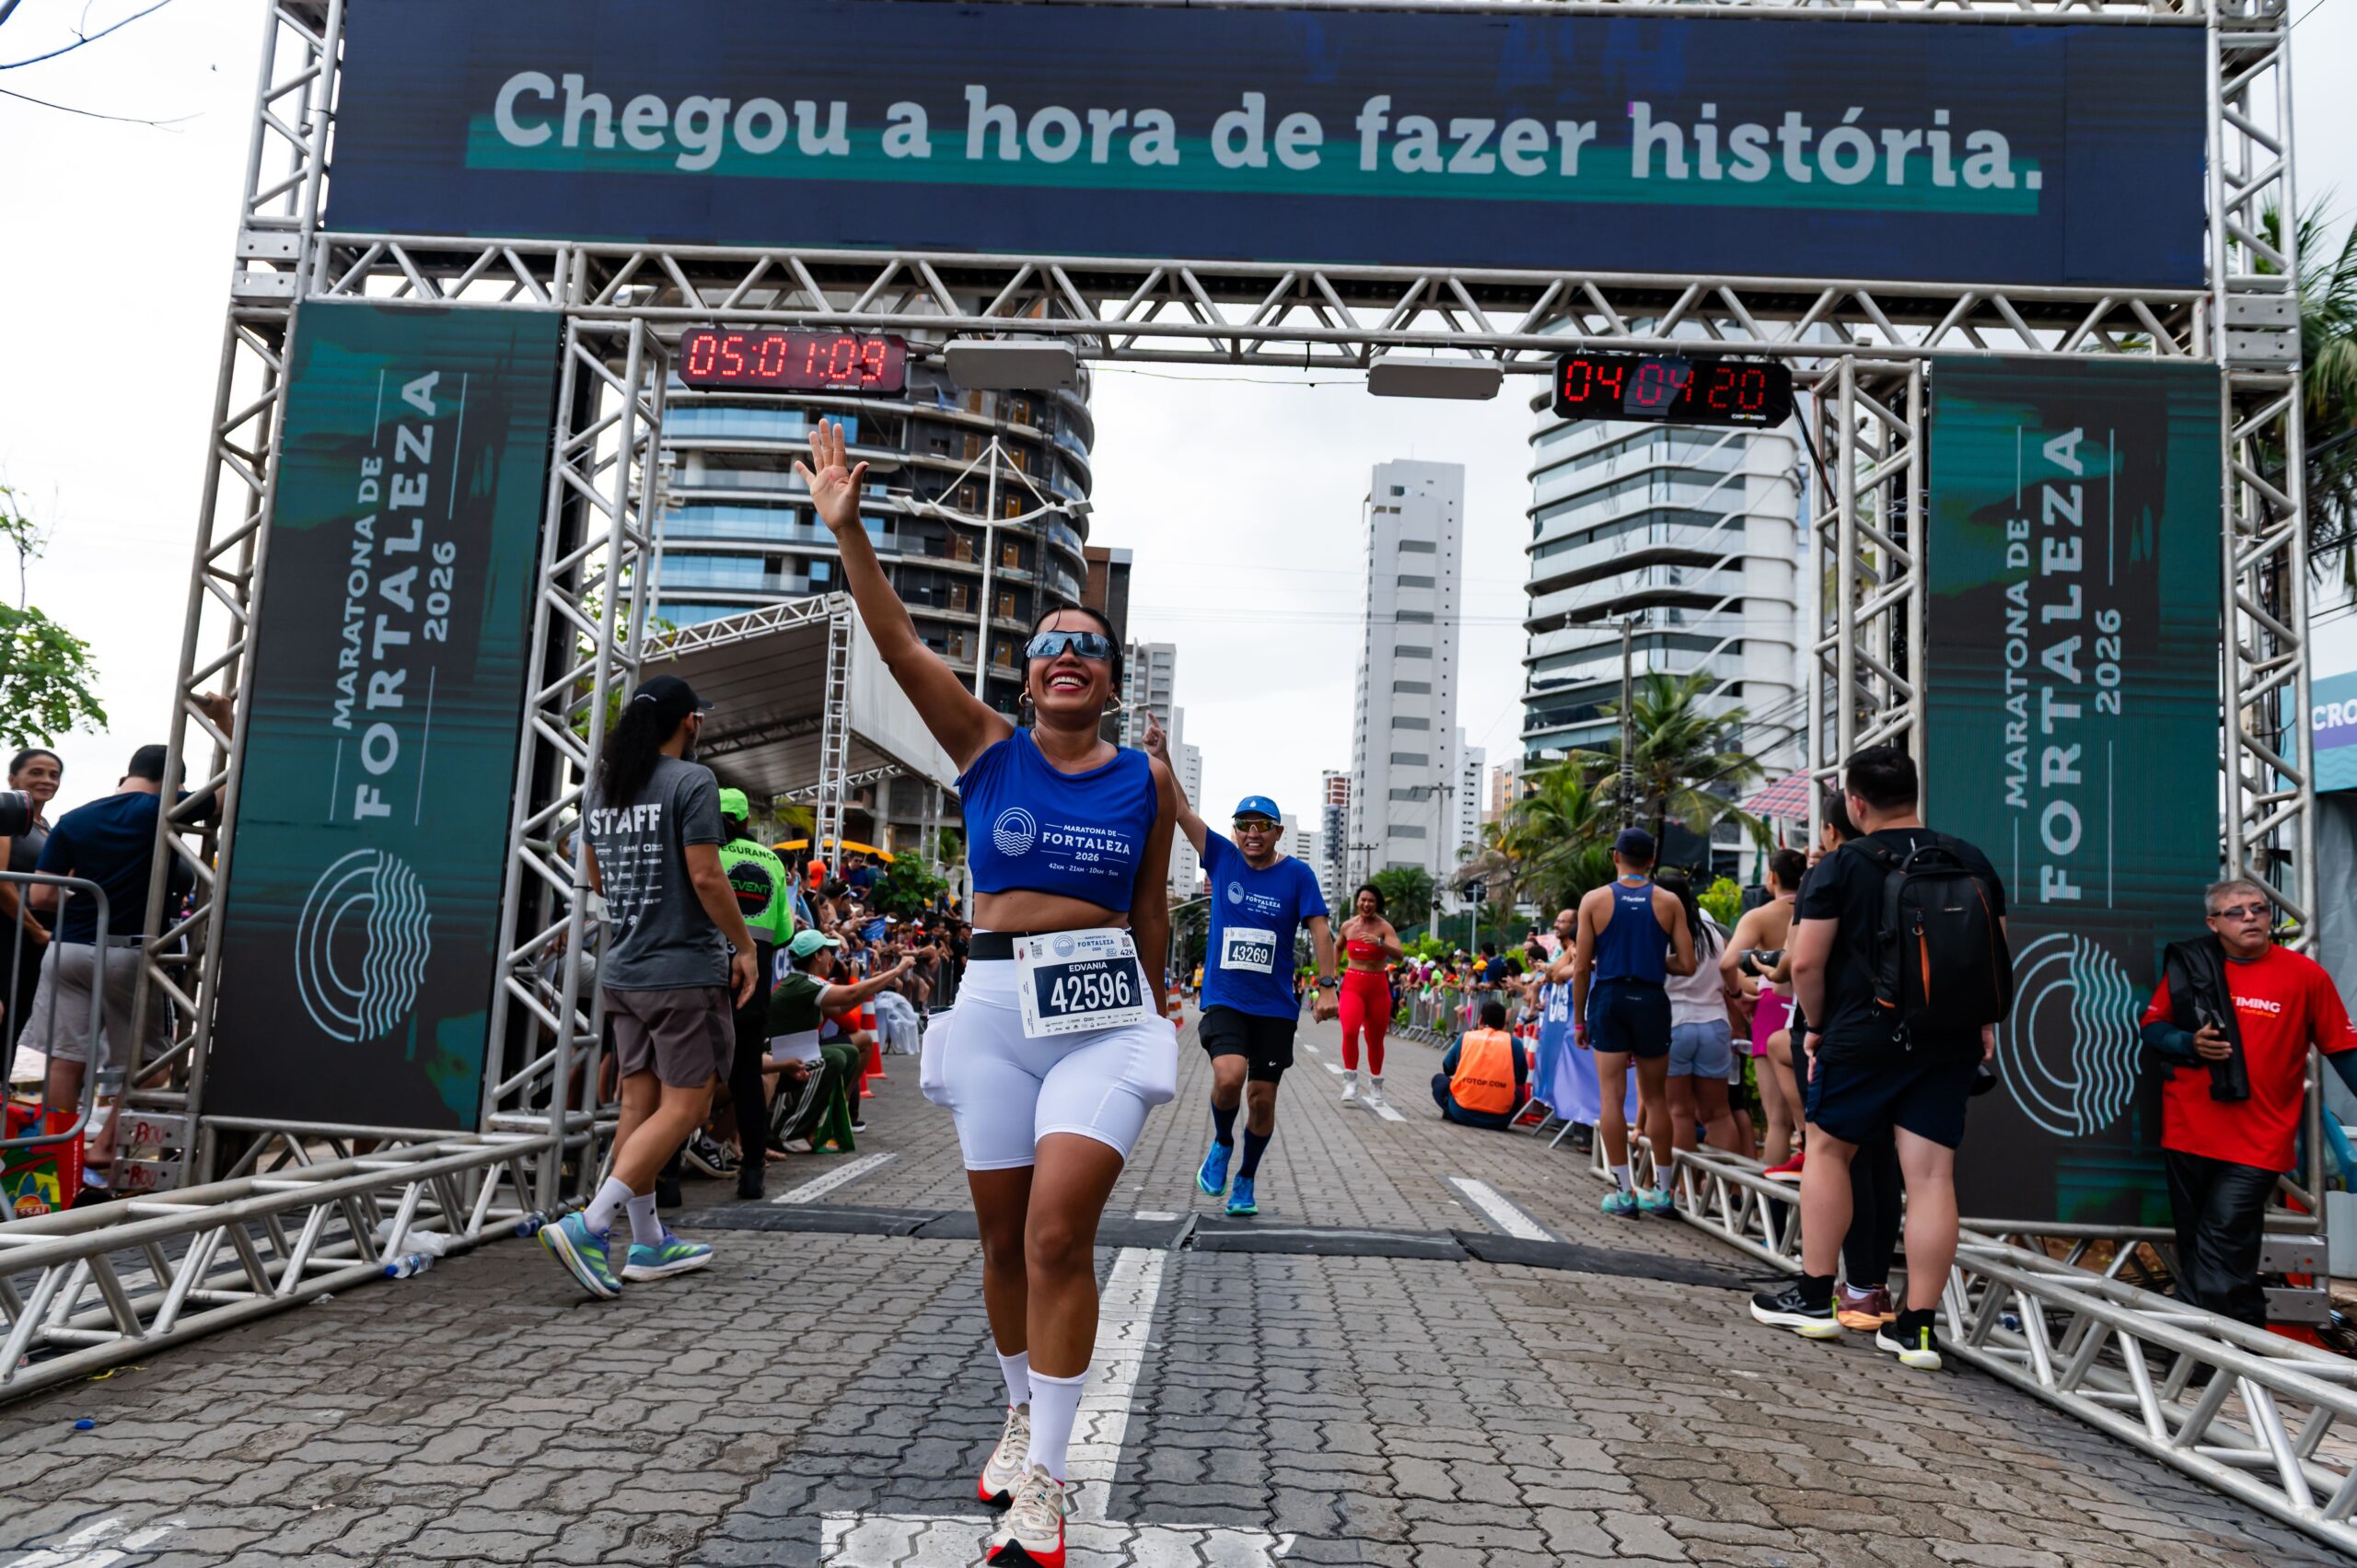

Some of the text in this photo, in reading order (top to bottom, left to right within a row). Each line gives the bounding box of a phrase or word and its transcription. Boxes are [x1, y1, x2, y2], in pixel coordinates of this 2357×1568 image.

[494, 71, 2043, 190] Chegou a hora de fazer história.
[689, 334, 887, 381] 05:01:09
[332, 456, 383, 730] MARATONA DE
[354, 370, 440, 820] FORTALEZA
[424, 541, 457, 643] 2026
[2004, 518, 2030, 809] MARATONA DE
[2040, 426, 2084, 903] FORTALEZA
[2095, 609, 2121, 715] 2026
[590, 803, 662, 836] STAFF
[1063, 824, 1106, 836] MARATONA
[721, 845, 778, 861] EGURANÇA
[1042, 831, 1131, 855] FORTALEZA
[1074, 852, 1099, 862] 2026
[1246, 895, 1281, 909] FORTALEZA
[1077, 939, 1115, 947] FORTALEZA
[1232, 945, 1268, 964] 43269
[1068, 961, 1108, 972] EDVANIA
[1051, 970, 1131, 1013] 42596
